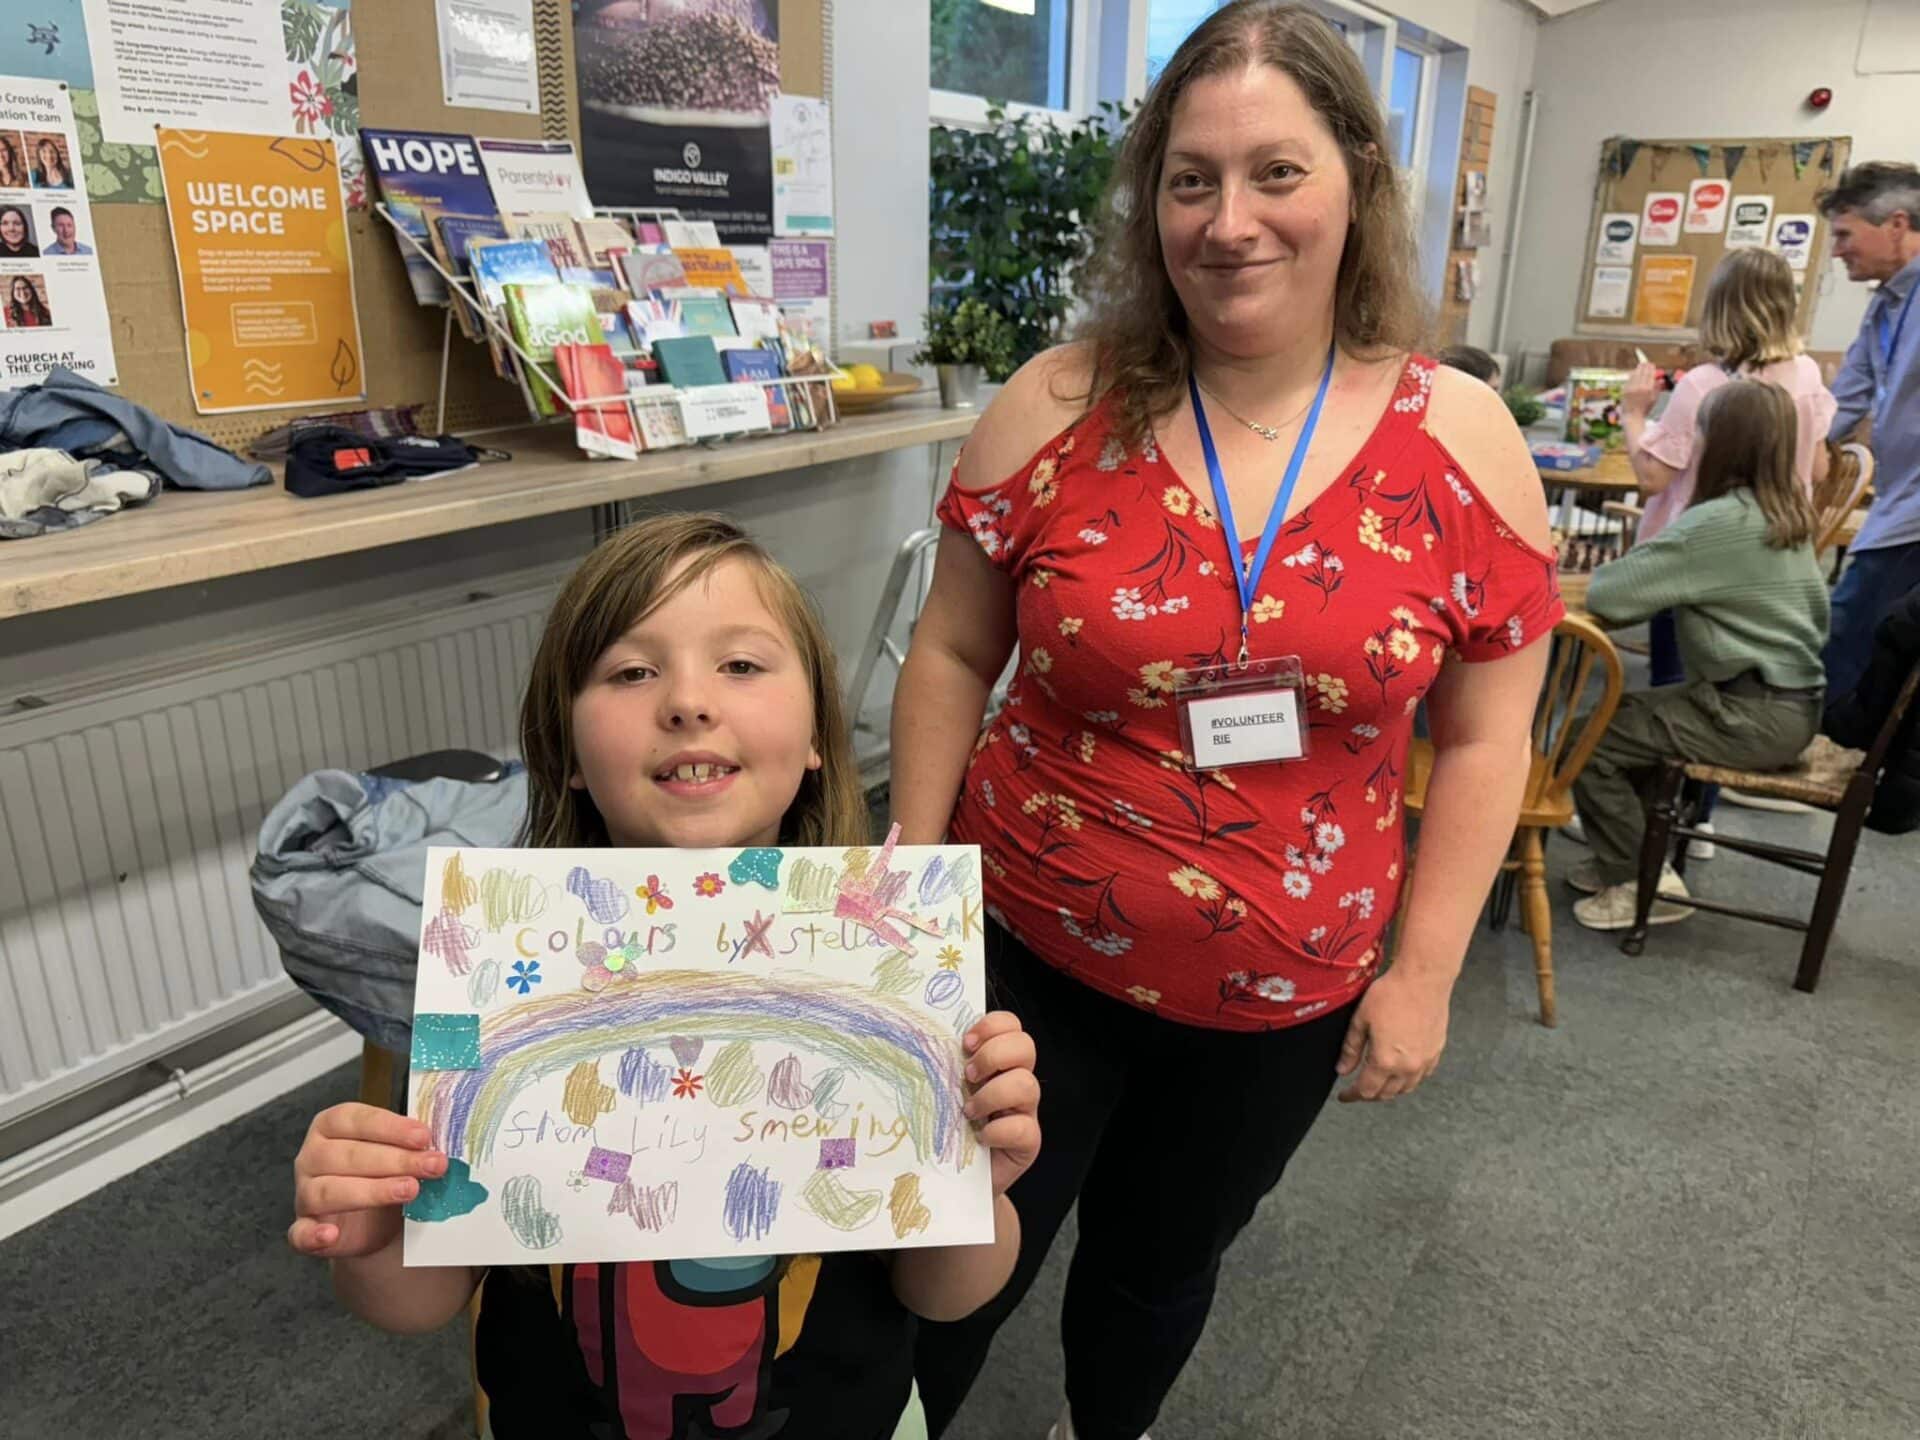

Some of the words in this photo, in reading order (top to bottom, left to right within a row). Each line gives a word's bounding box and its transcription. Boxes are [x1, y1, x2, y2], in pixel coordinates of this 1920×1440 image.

[5, 92, 54, 110] Crossing
[30, 110, 62, 122] Team
[370, 138, 480, 175] HOPE
[653, 168, 691, 184] INDIGO
[692, 170, 729, 186] VALLEY
[187, 181, 326, 210] WELCOME
[191, 210, 285, 235] SPACE
[5, 352, 58, 365] CHURCH
[61, 351, 75, 361] AT
[7, 363, 31, 374] THE
[1211, 712, 1285, 729] #VOLUNTEER
[1212, 734, 1231, 745] RIE
[716, 922, 748, 963] by
